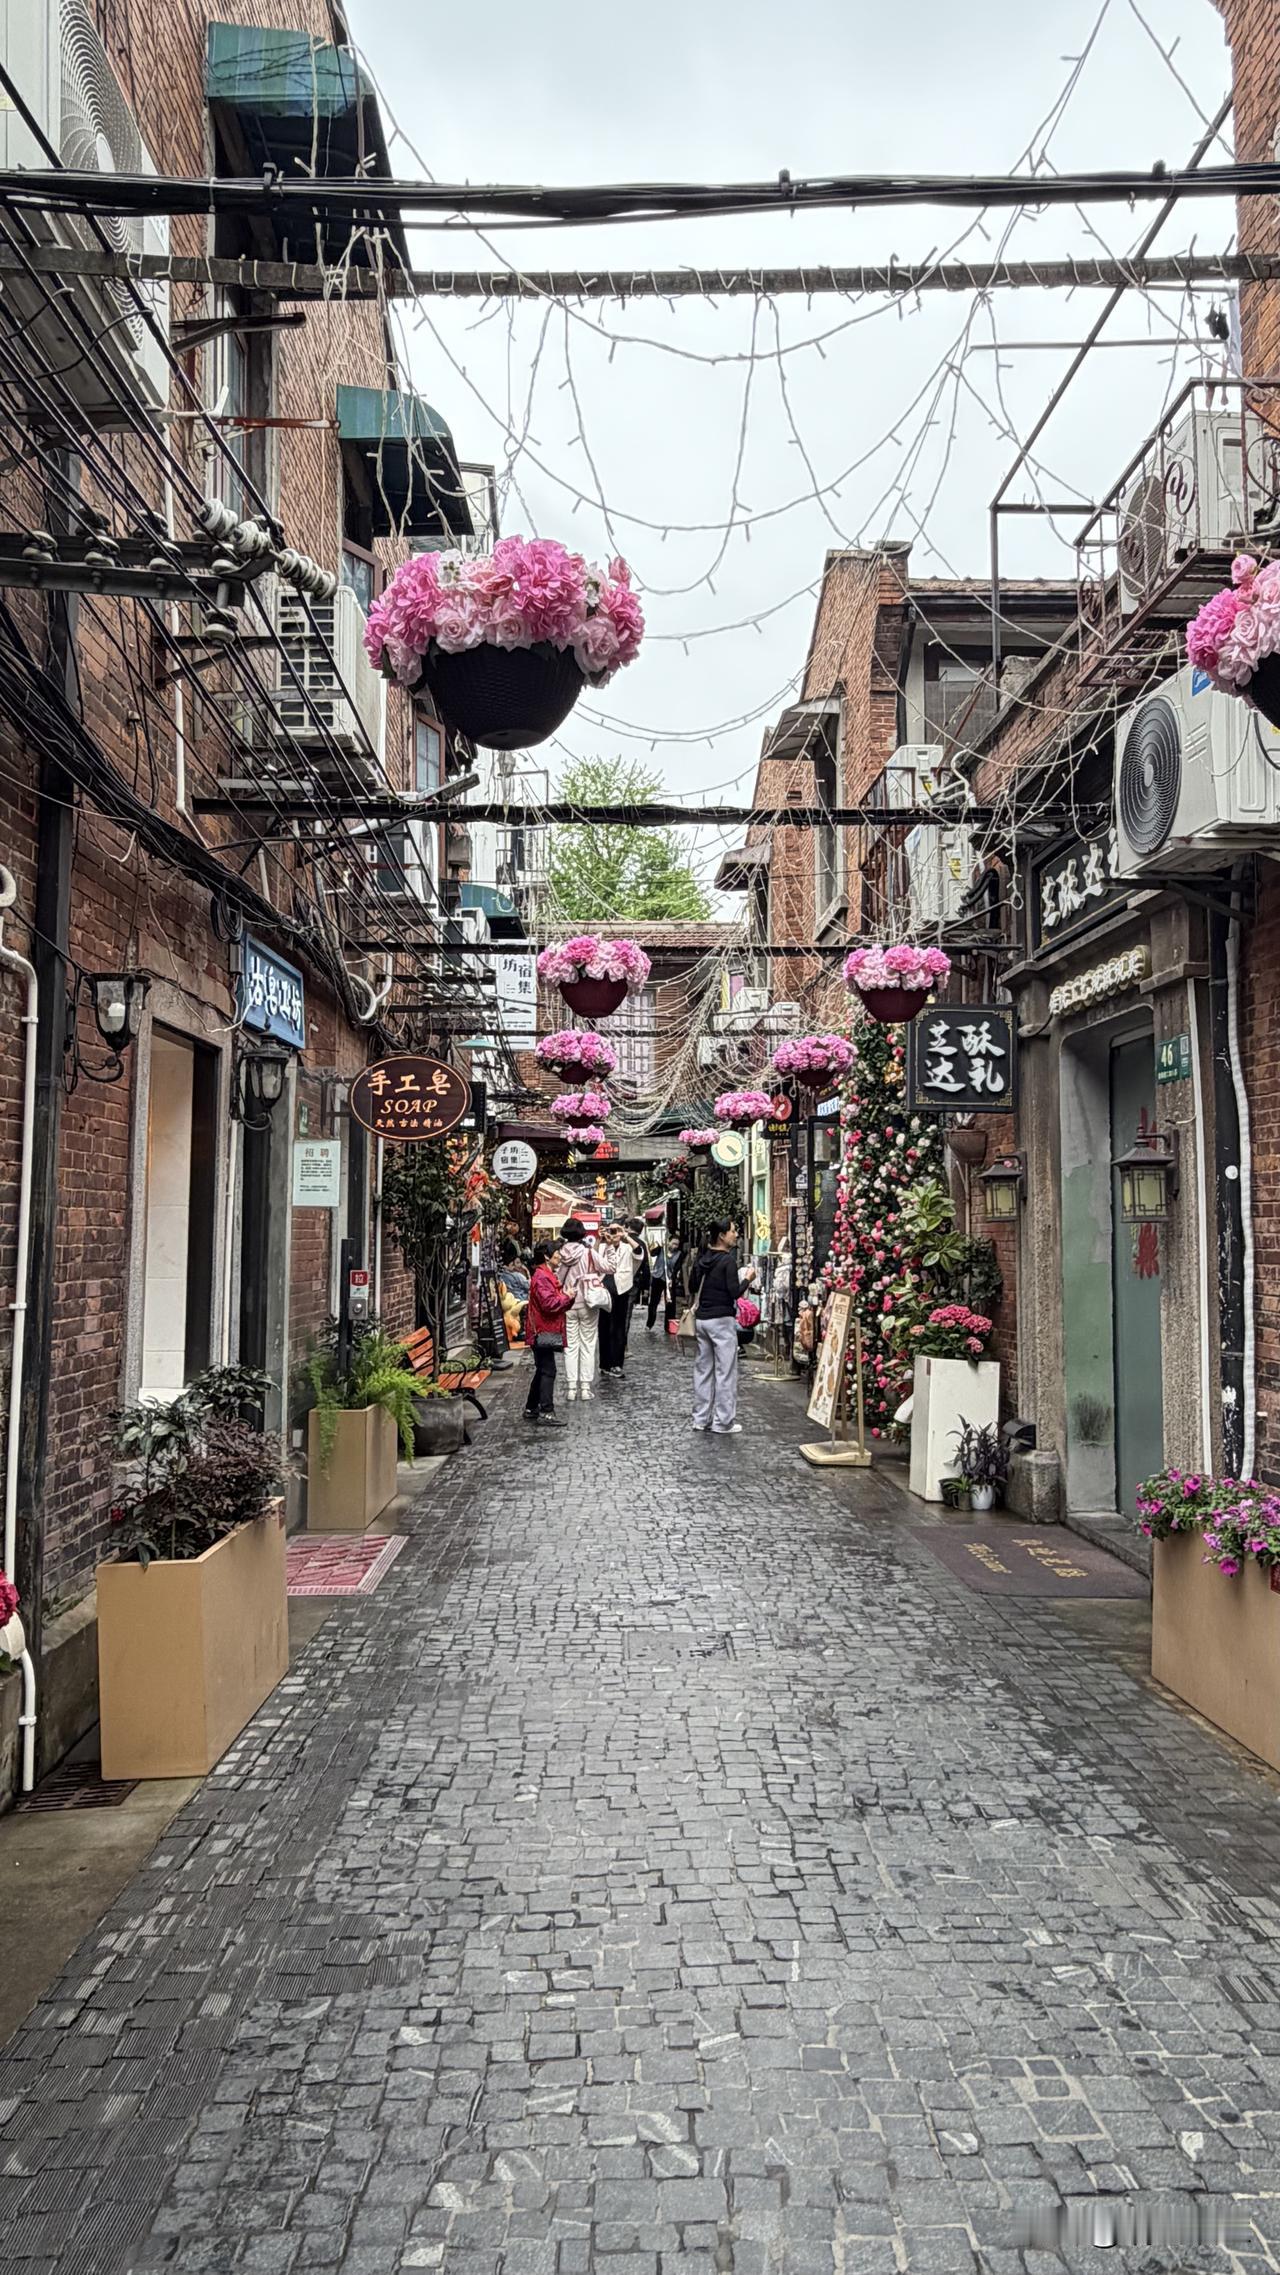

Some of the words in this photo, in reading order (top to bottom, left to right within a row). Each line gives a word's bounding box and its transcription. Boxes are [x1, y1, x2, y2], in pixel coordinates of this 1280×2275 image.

[1160, 1043, 1173, 1067] 46
[367, 1068, 451, 1096] 手工皂
[380, 1098, 438, 1115] SOAP
[375, 1118, 395, 1128] 天然
